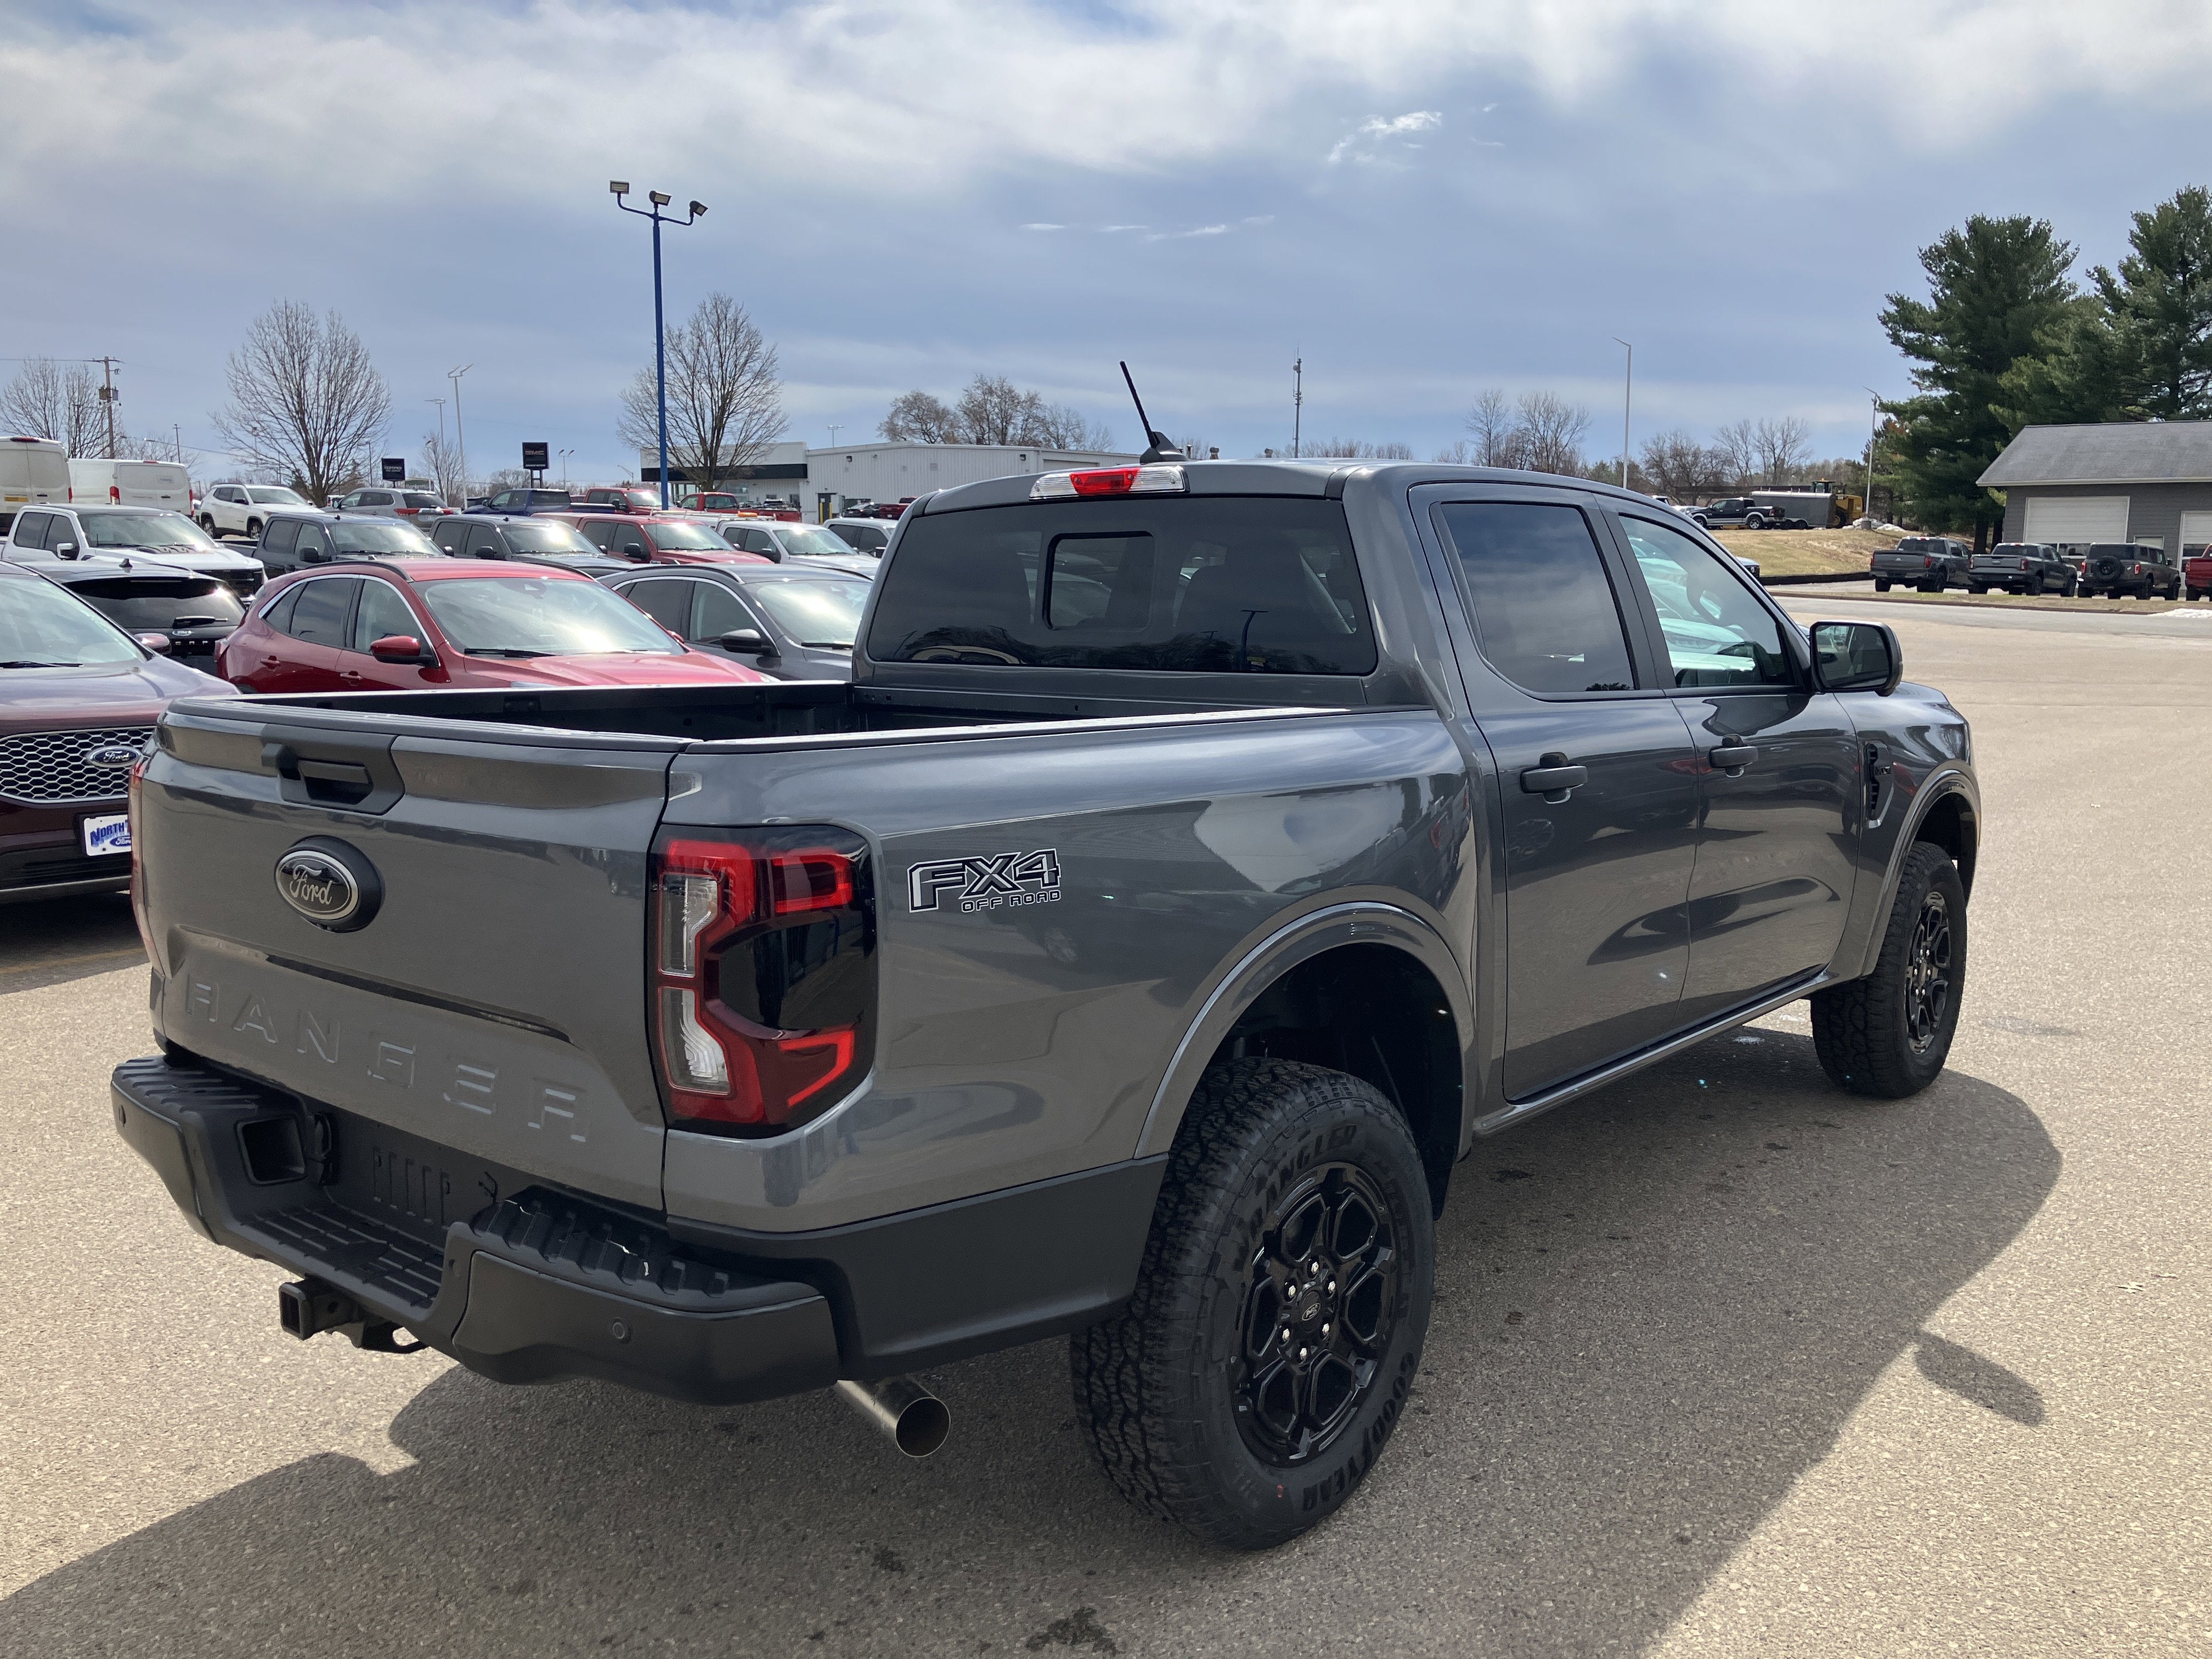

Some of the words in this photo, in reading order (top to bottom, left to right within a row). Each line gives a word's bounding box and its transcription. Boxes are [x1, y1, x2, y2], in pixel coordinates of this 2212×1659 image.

[290, 864, 336, 905] Ford
[907, 848, 1061, 913] FX4
[961, 896, 1003, 913] OFF
[1009, 889, 1061, 907] ROAD
[185, 977, 588, 1142] RANGER
[1303, 1352, 1415, 1511] GOODYEAR
